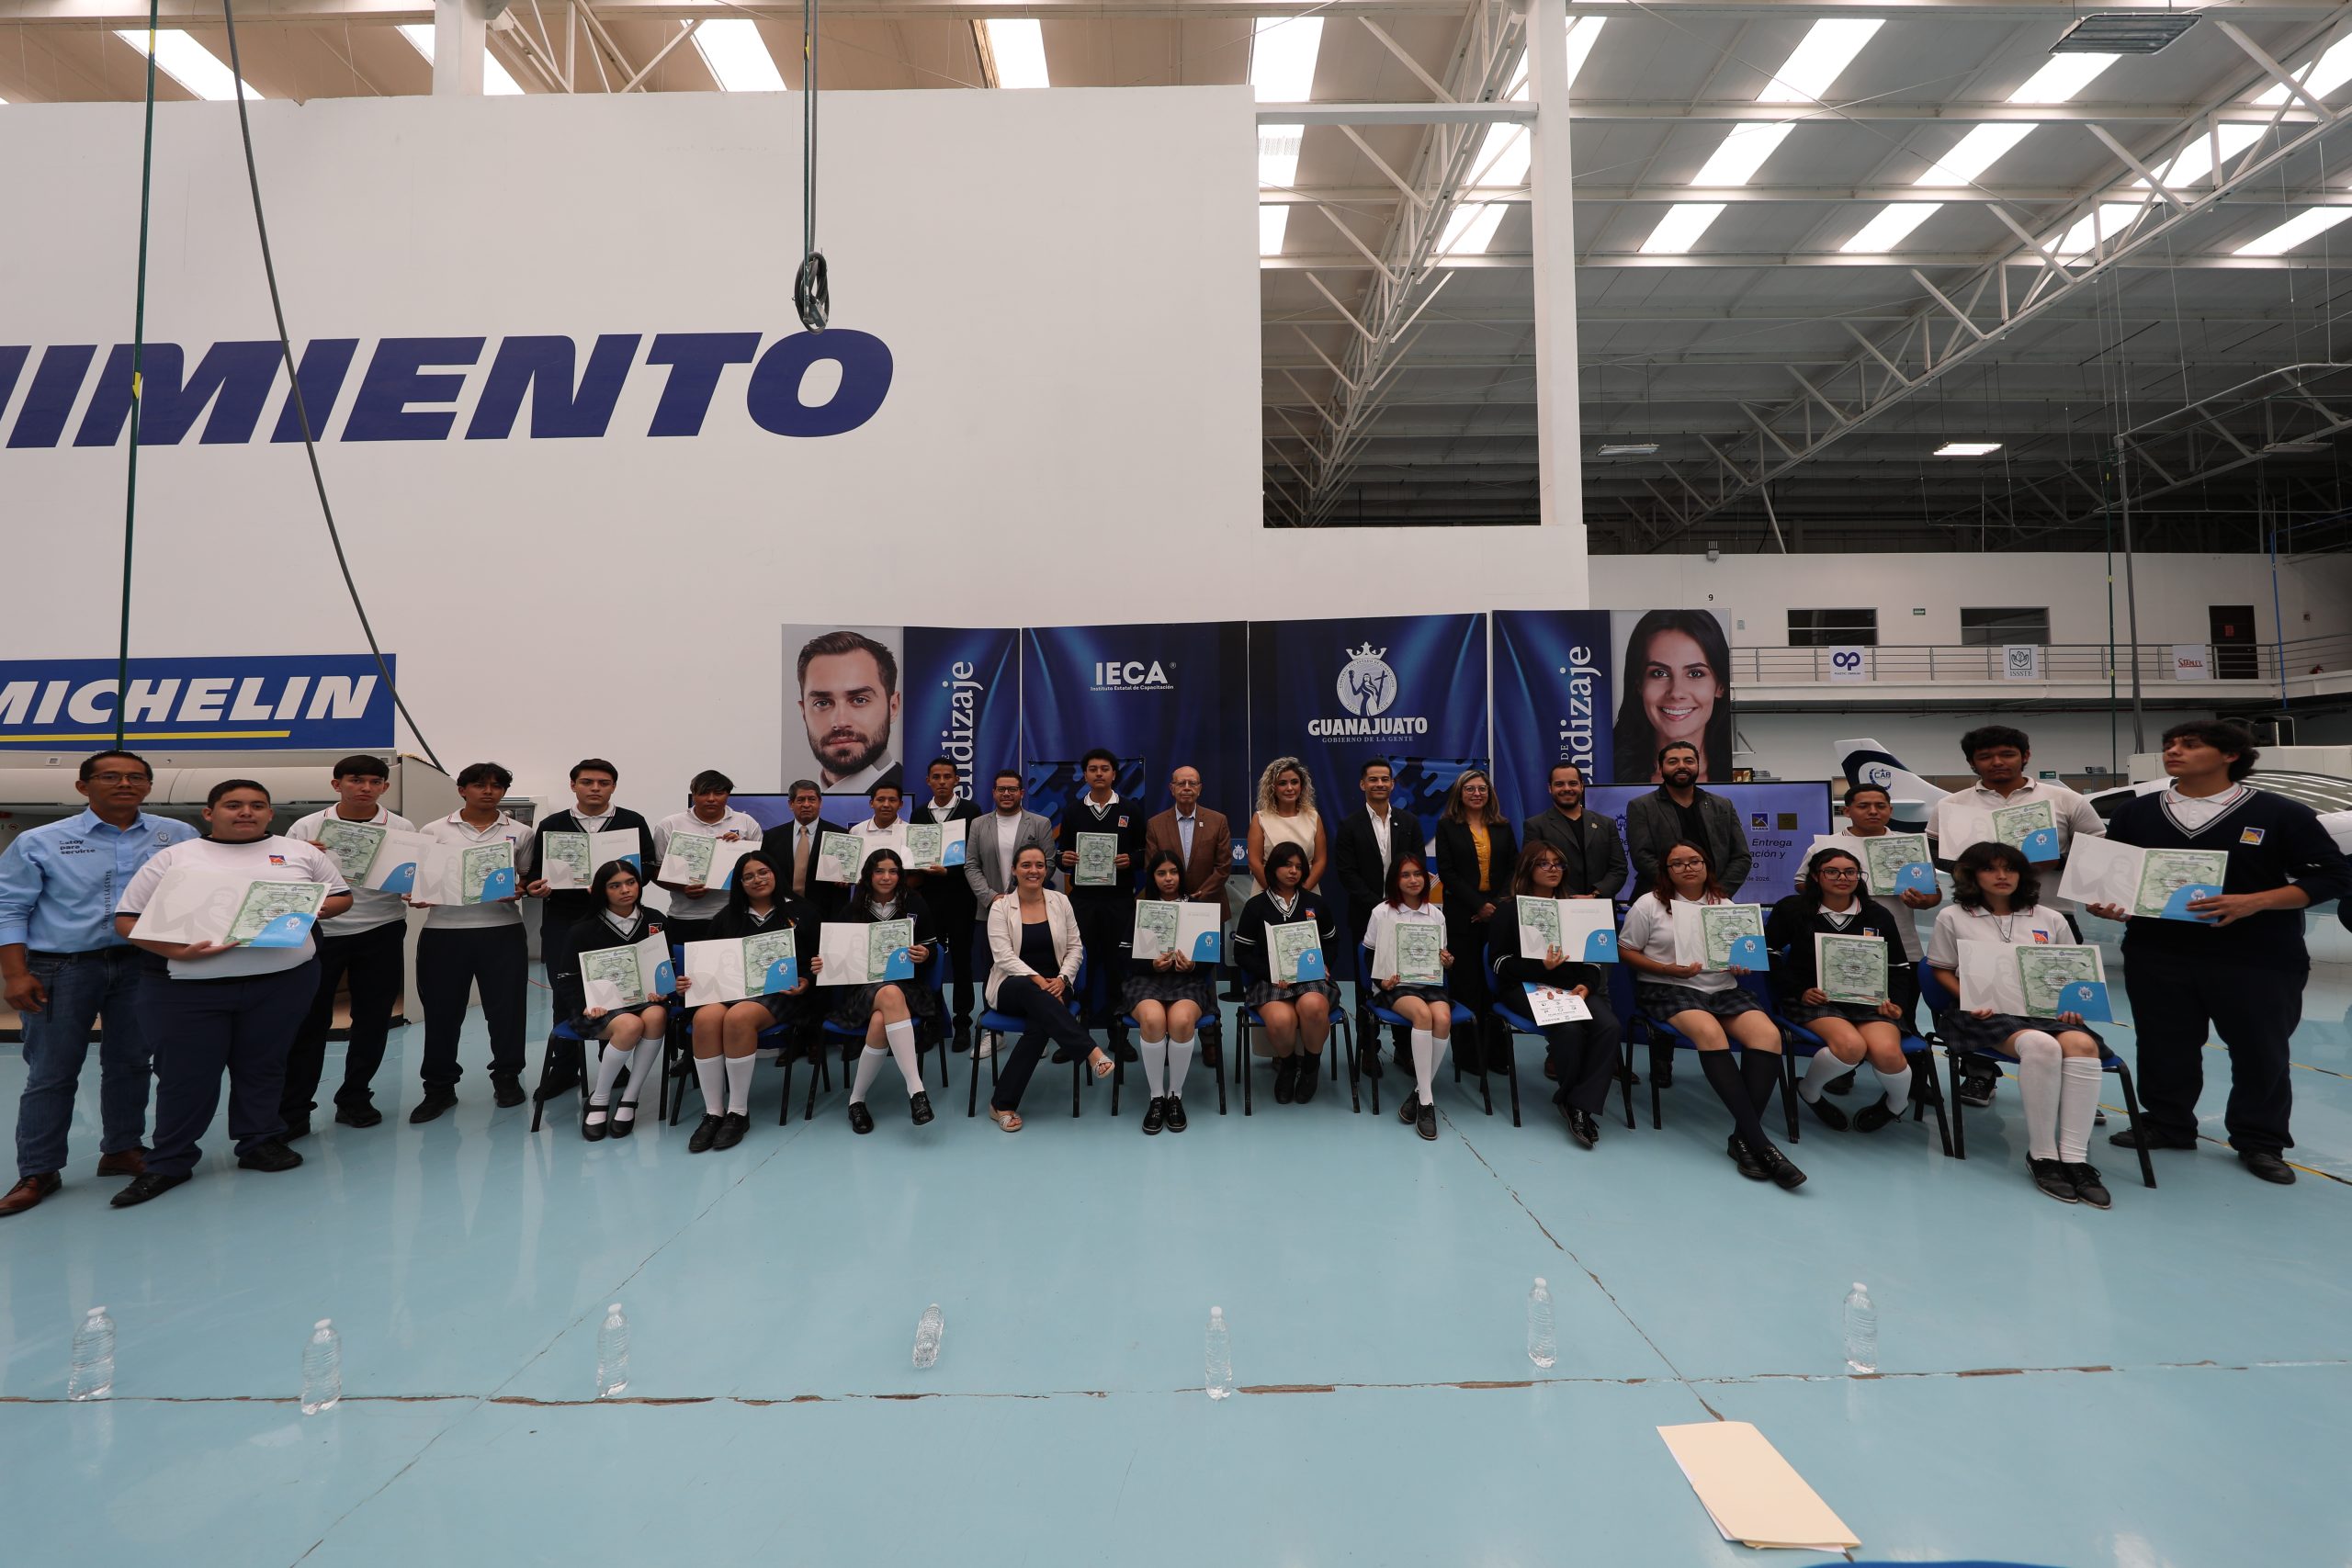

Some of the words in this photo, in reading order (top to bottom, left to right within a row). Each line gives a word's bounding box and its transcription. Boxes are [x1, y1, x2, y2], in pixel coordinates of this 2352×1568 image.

[0, 329, 893, 448] IMIENTO
[1708, 593, 1713, 602] 9
[1095, 660, 1168, 685] IECA
[1307, 717, 1428, 736] GUANAJUATO
[1752, 838, 1792, 849] Entrega
[1779, 852, 1786, 860] y
